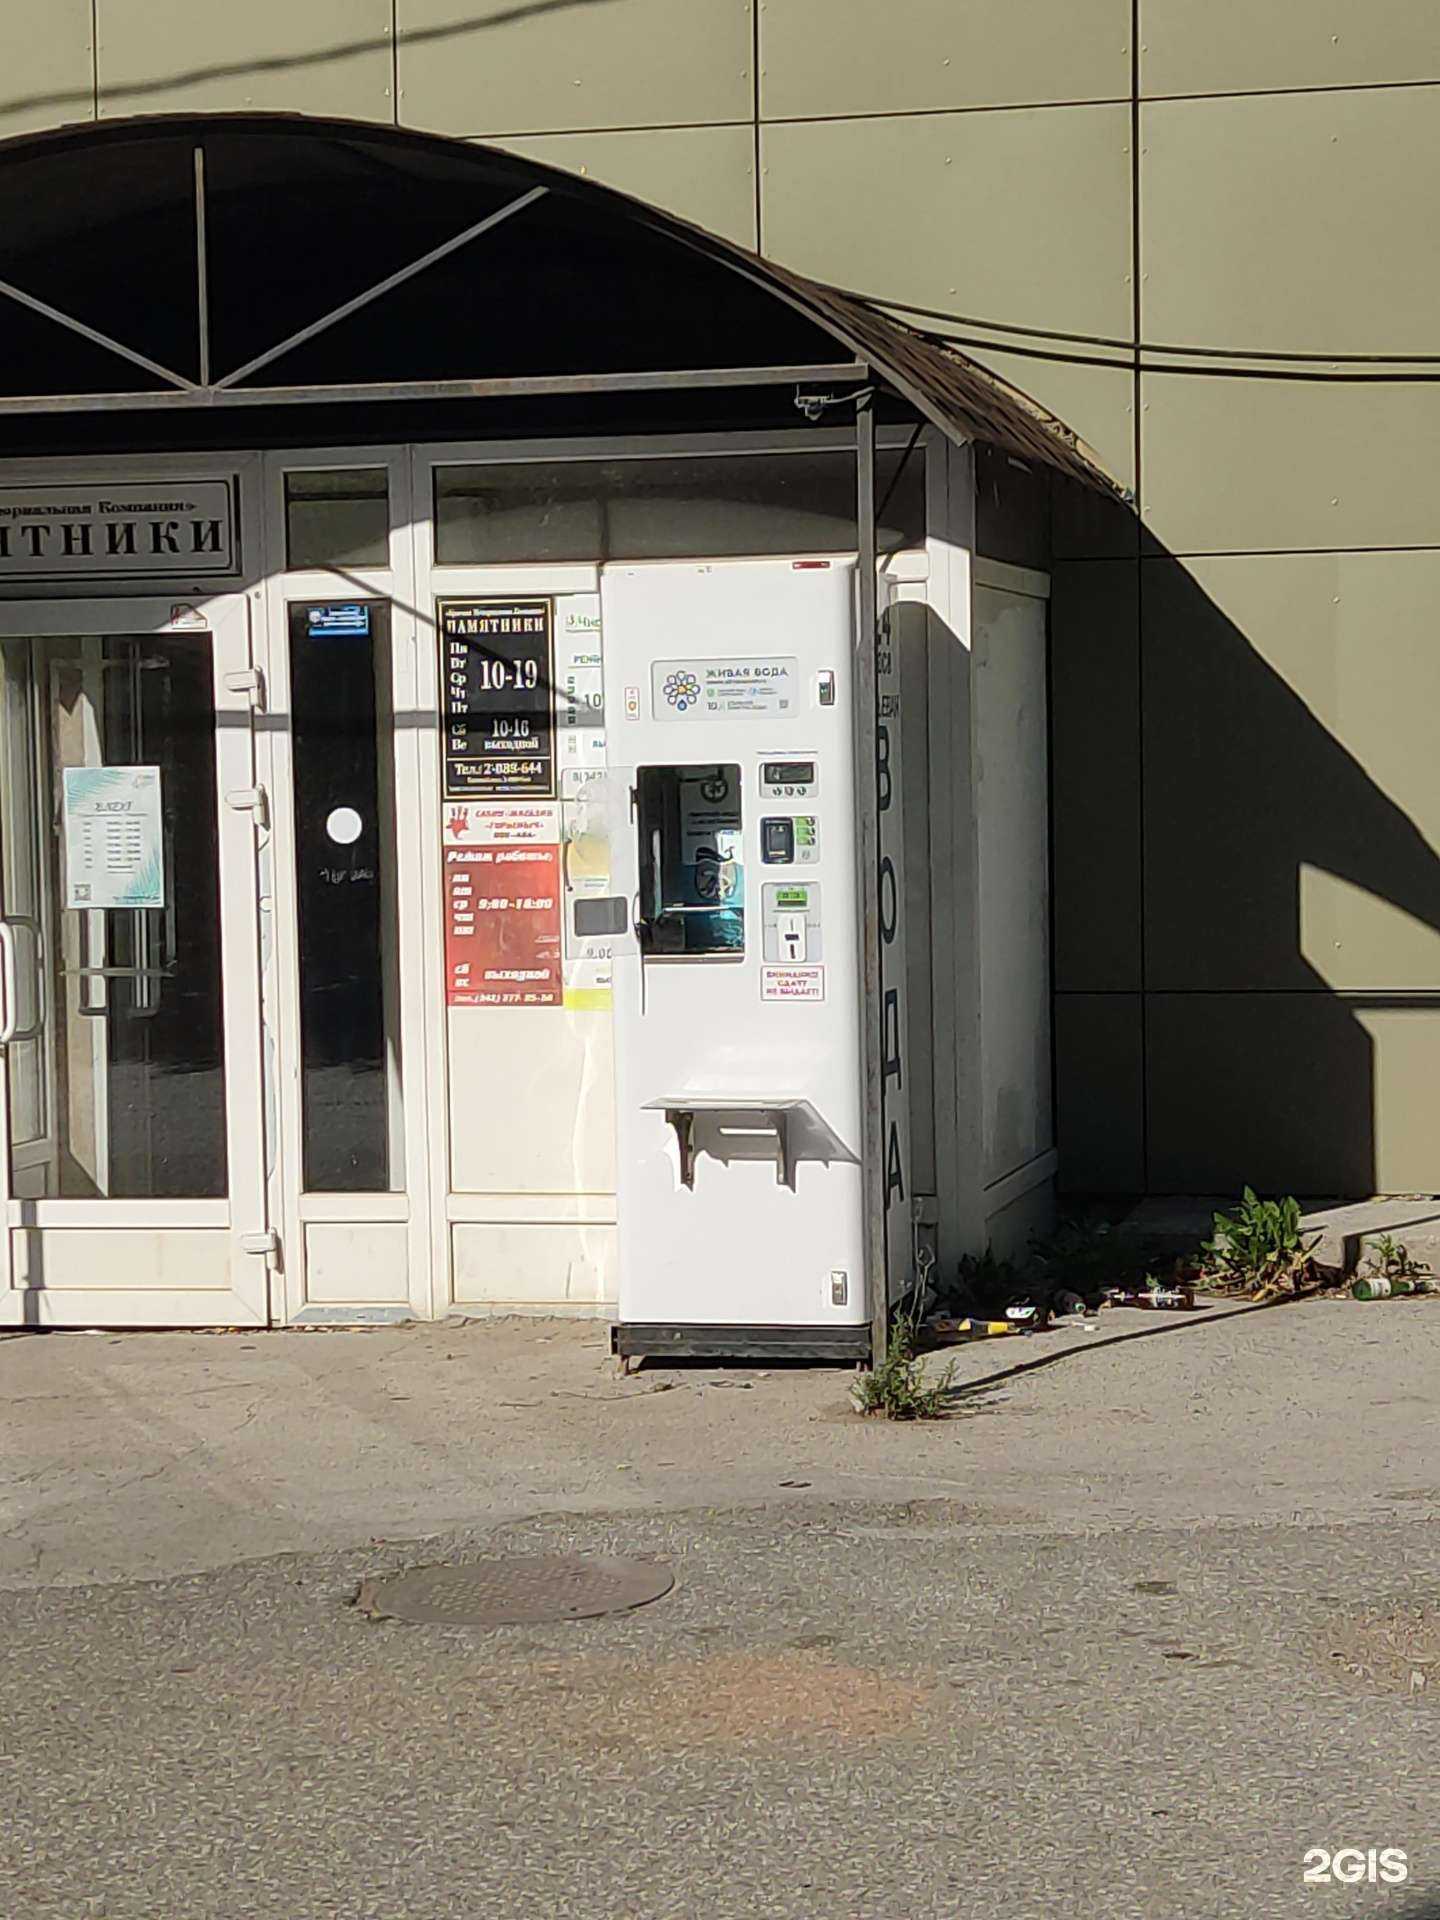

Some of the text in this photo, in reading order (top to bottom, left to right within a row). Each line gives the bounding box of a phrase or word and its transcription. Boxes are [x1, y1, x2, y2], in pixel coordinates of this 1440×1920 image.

[446, 617, 544, 634] ПАМЯТНИКИ
[480, 659, 538, 691] 10-19
[706, 666, 789, 678] ЖИВАЯ ВОДА
